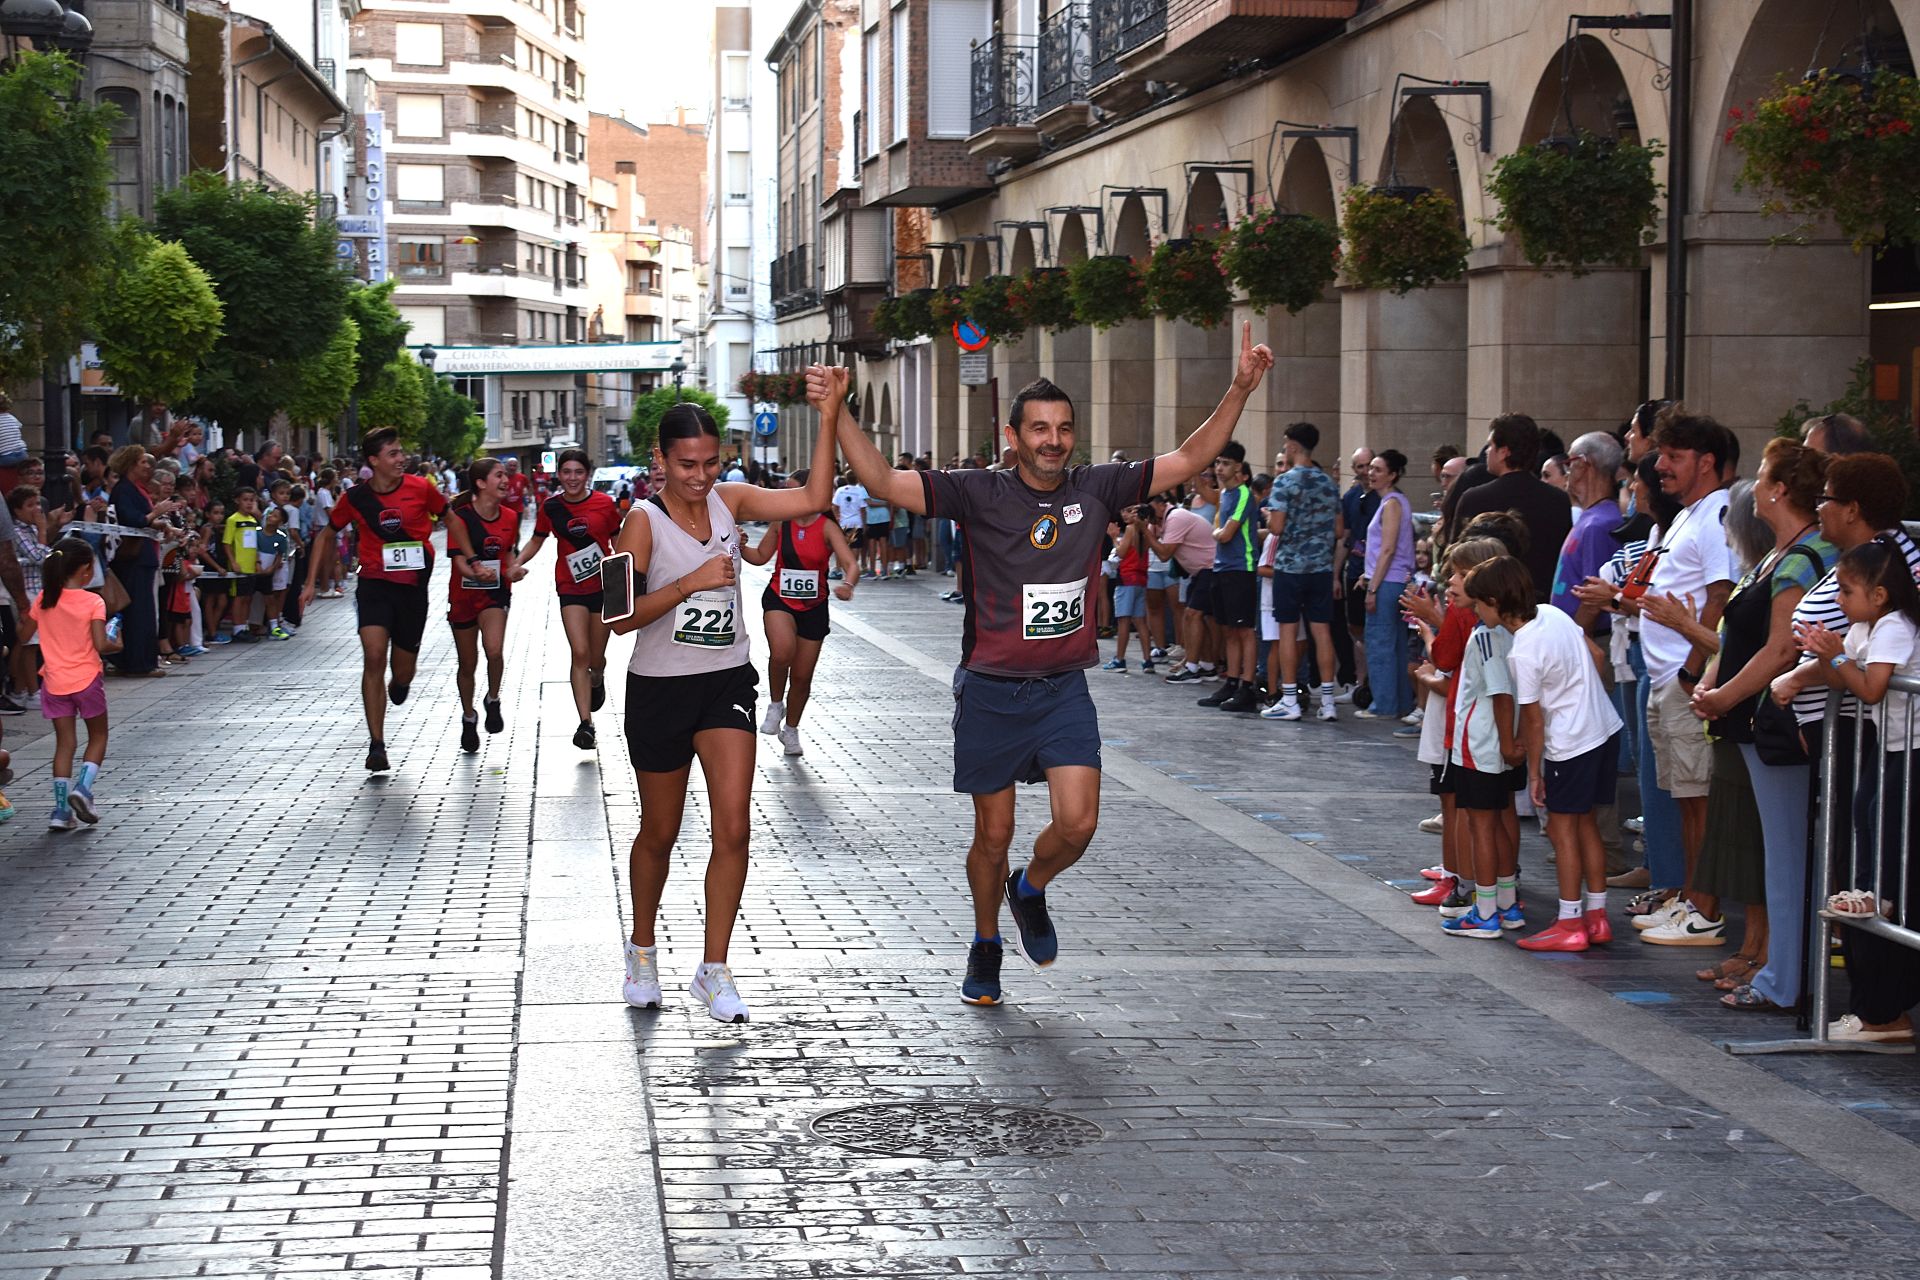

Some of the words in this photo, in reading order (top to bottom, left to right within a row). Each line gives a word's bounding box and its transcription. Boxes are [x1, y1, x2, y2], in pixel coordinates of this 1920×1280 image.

[482, 361, 531, 371] HERMOSA
[533, 361, 552, 370] DEL
[555, 360, 597, 369] MUNDO
[598, 359, 641, 369] ENTERO
[393, 549, 407, 562] 81
[572, 552, 601, 573] 164
[784, 578, 814, 591] 166
[1031, 596, 1082, 624] 236
[681, 607, 734, 633] 222
